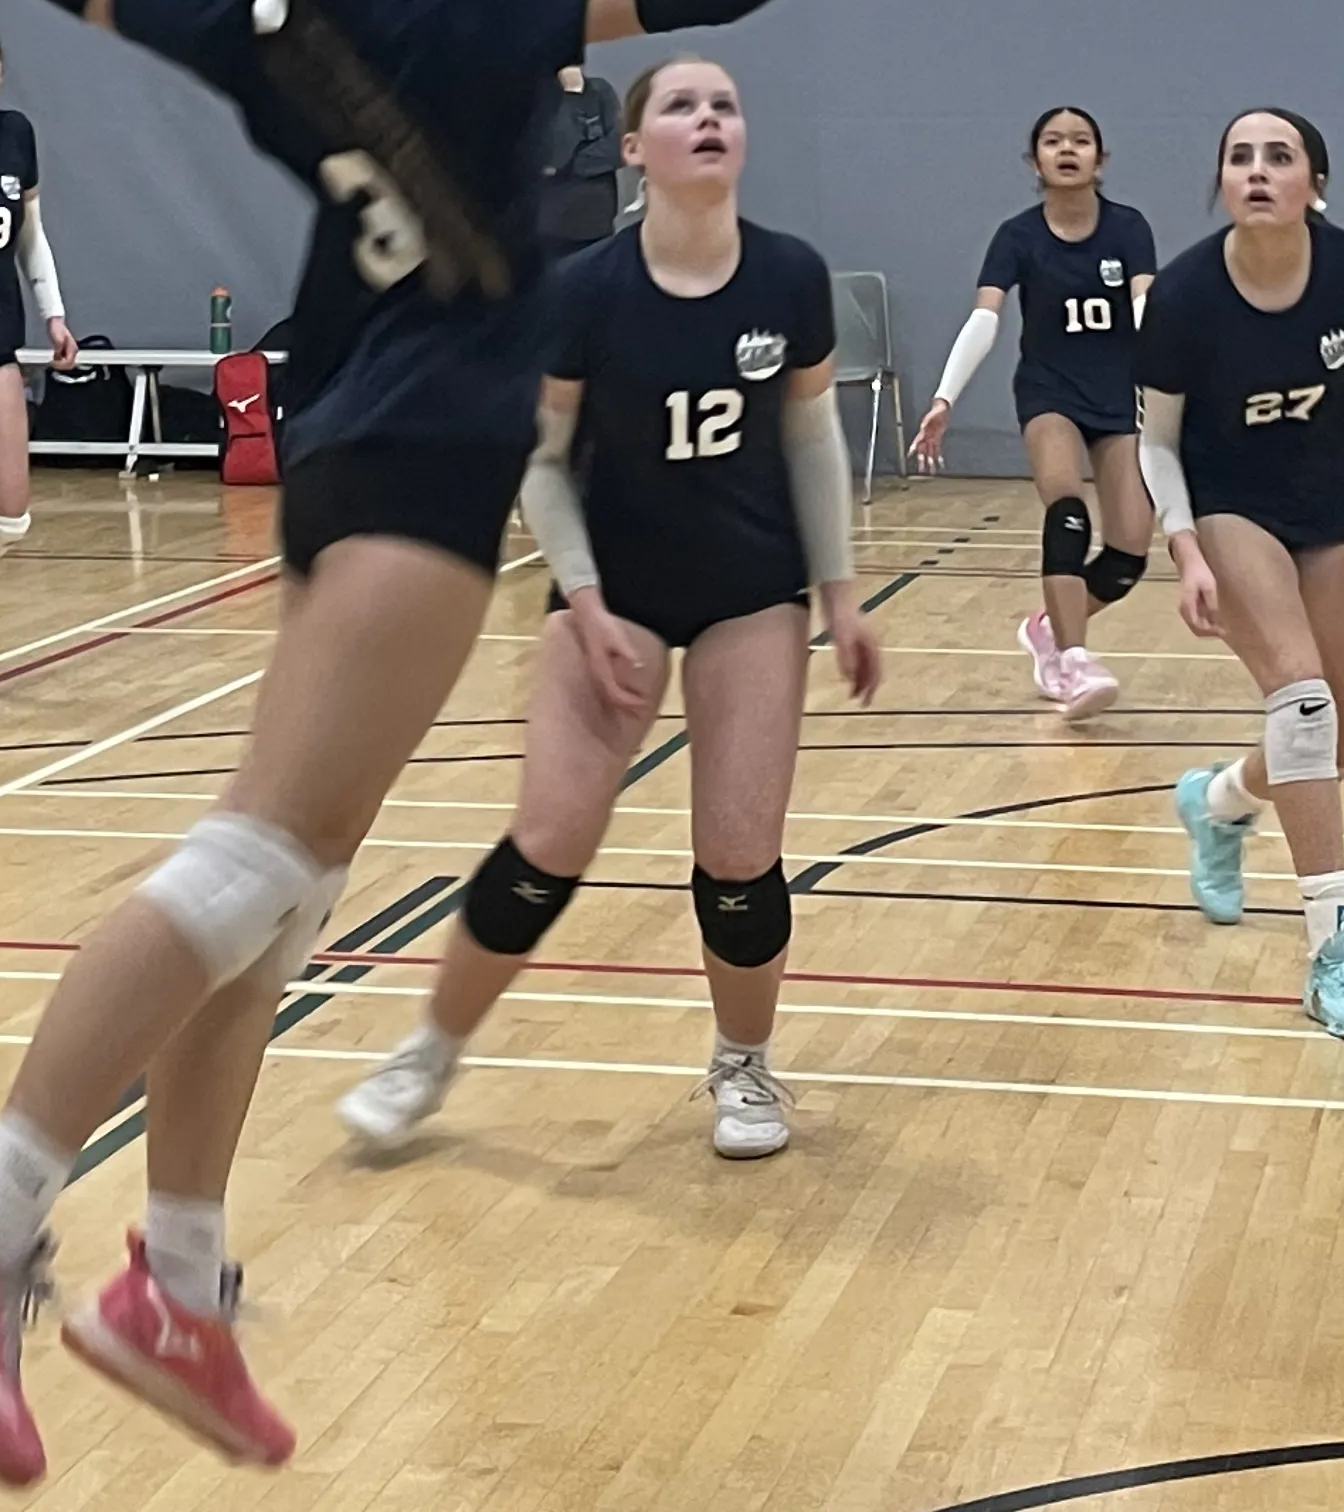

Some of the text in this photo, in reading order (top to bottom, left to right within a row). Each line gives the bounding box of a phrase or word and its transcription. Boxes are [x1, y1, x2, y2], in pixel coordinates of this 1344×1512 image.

[1064, 298, 1112, 334] 10
[665, 387, 744, 461] 12
[1244, 384, 1326, 428] 27
